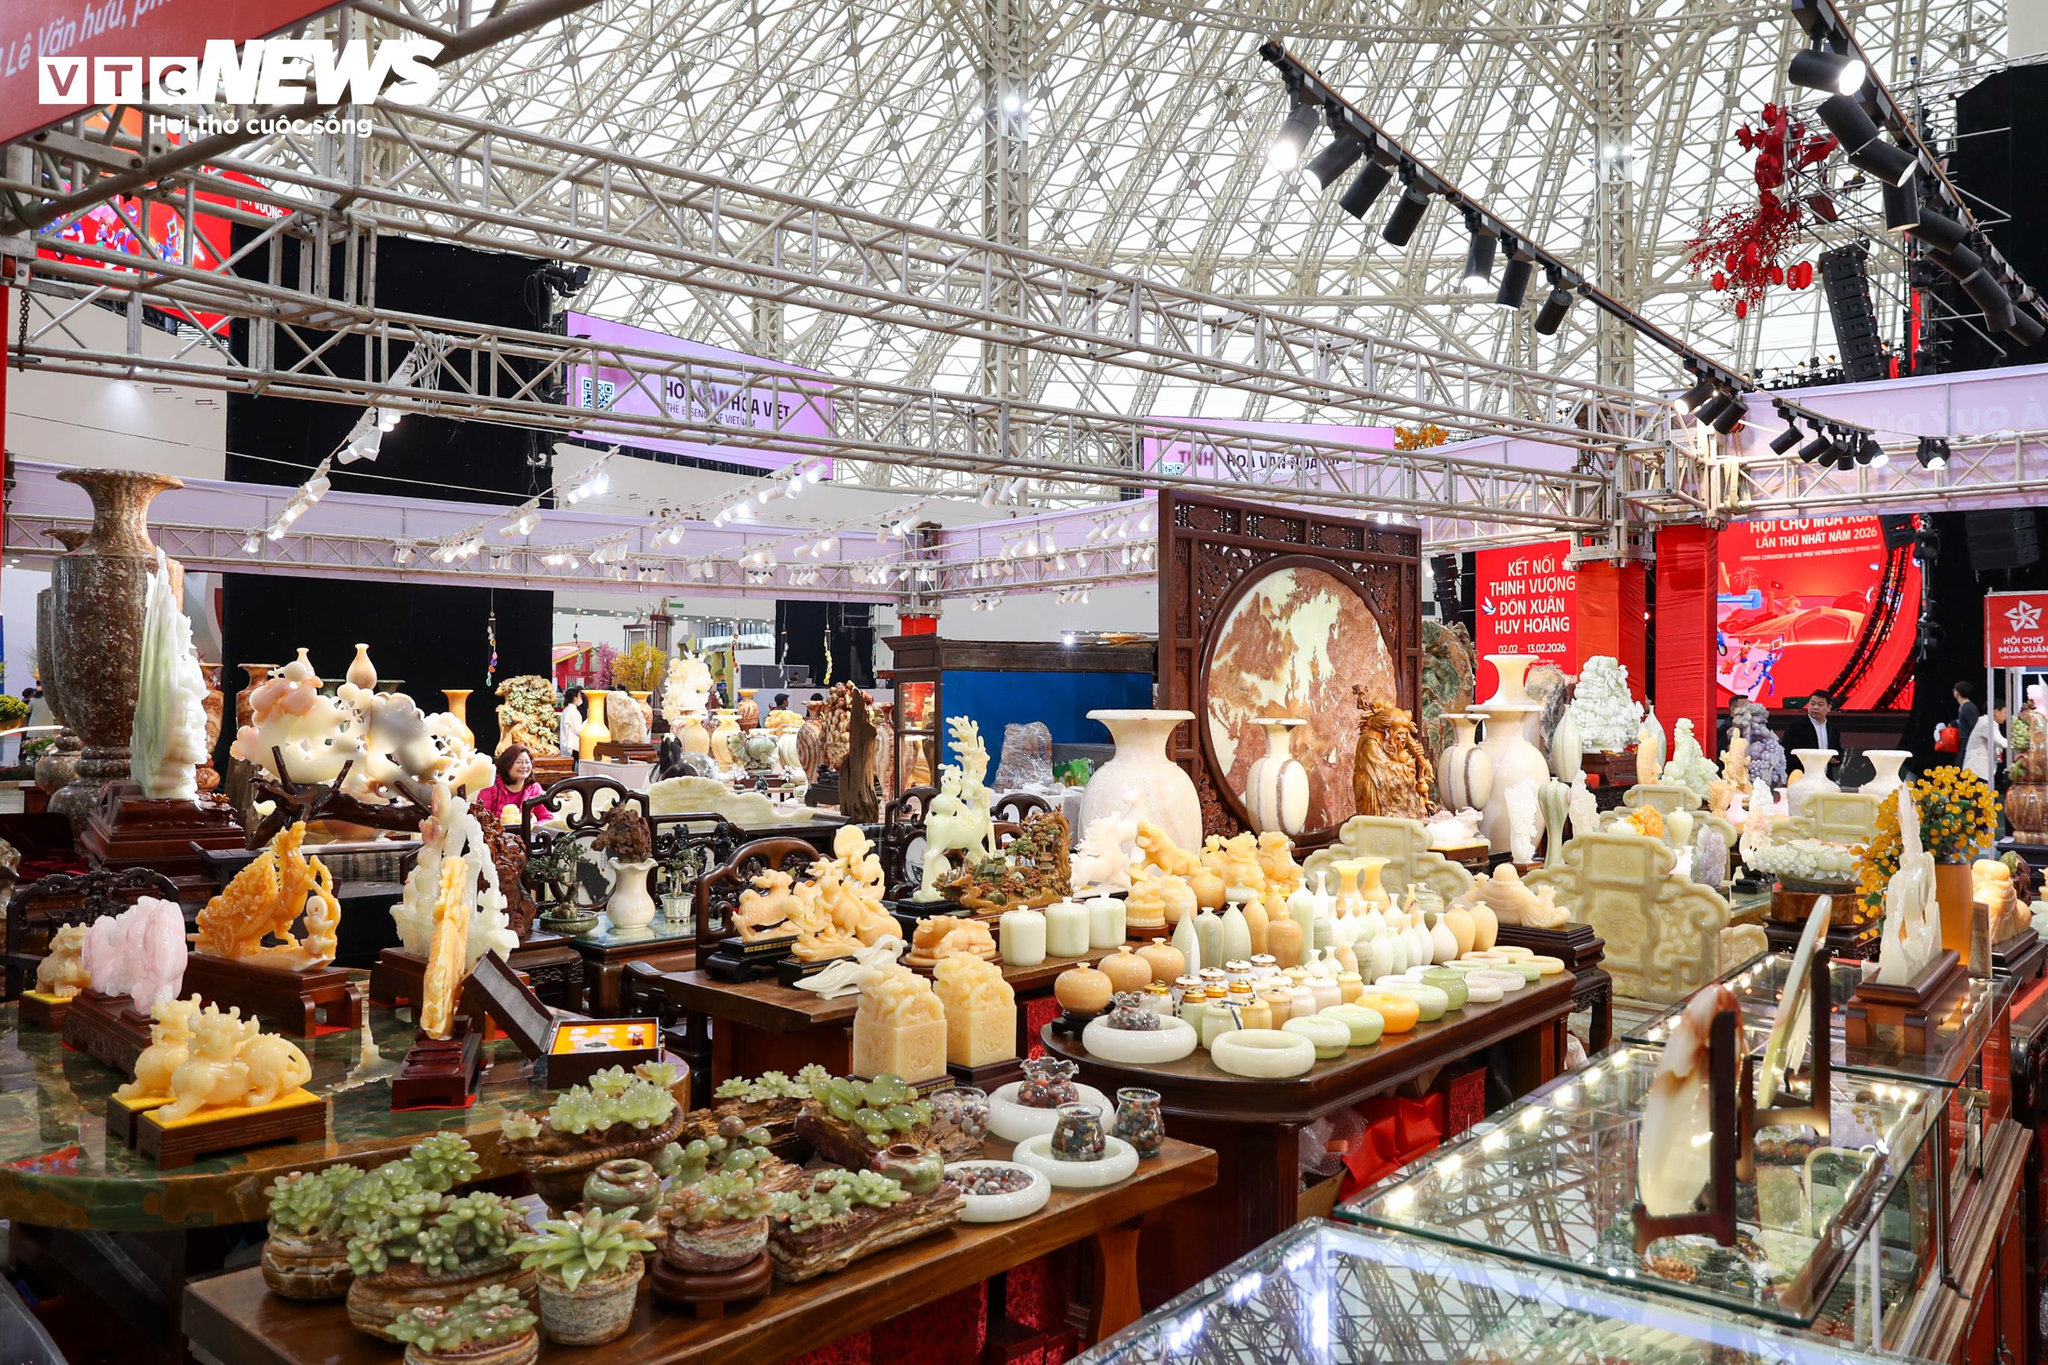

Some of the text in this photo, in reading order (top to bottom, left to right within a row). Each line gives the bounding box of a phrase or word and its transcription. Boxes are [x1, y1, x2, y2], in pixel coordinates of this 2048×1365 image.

[5, 32, 32, 77] Lê
[38, 16, 77, 58] Văn
[1801, 529, 1827, 545] NHẤT
[1828, 527, 1852, 542] NĂM
[1853, 525, 1878, 540] 2026
[1508, 553, 1555, 577] KẾT NỐI
[1489, 575, 1576, 598] THỊNH VƯỢNG
[1499, 595, 1565, 616] ĐÓN XUÂN
[1495, 615, 1570, 635] HUY HOÀNG
[1498, 644, 1518, 654] 02.02
[1526, 642, 1567, 654] 13.02.2026
[1998, 645, 2020, 654] MÙA
[2003, 635, 2044, 646] HỘI CHỢ
